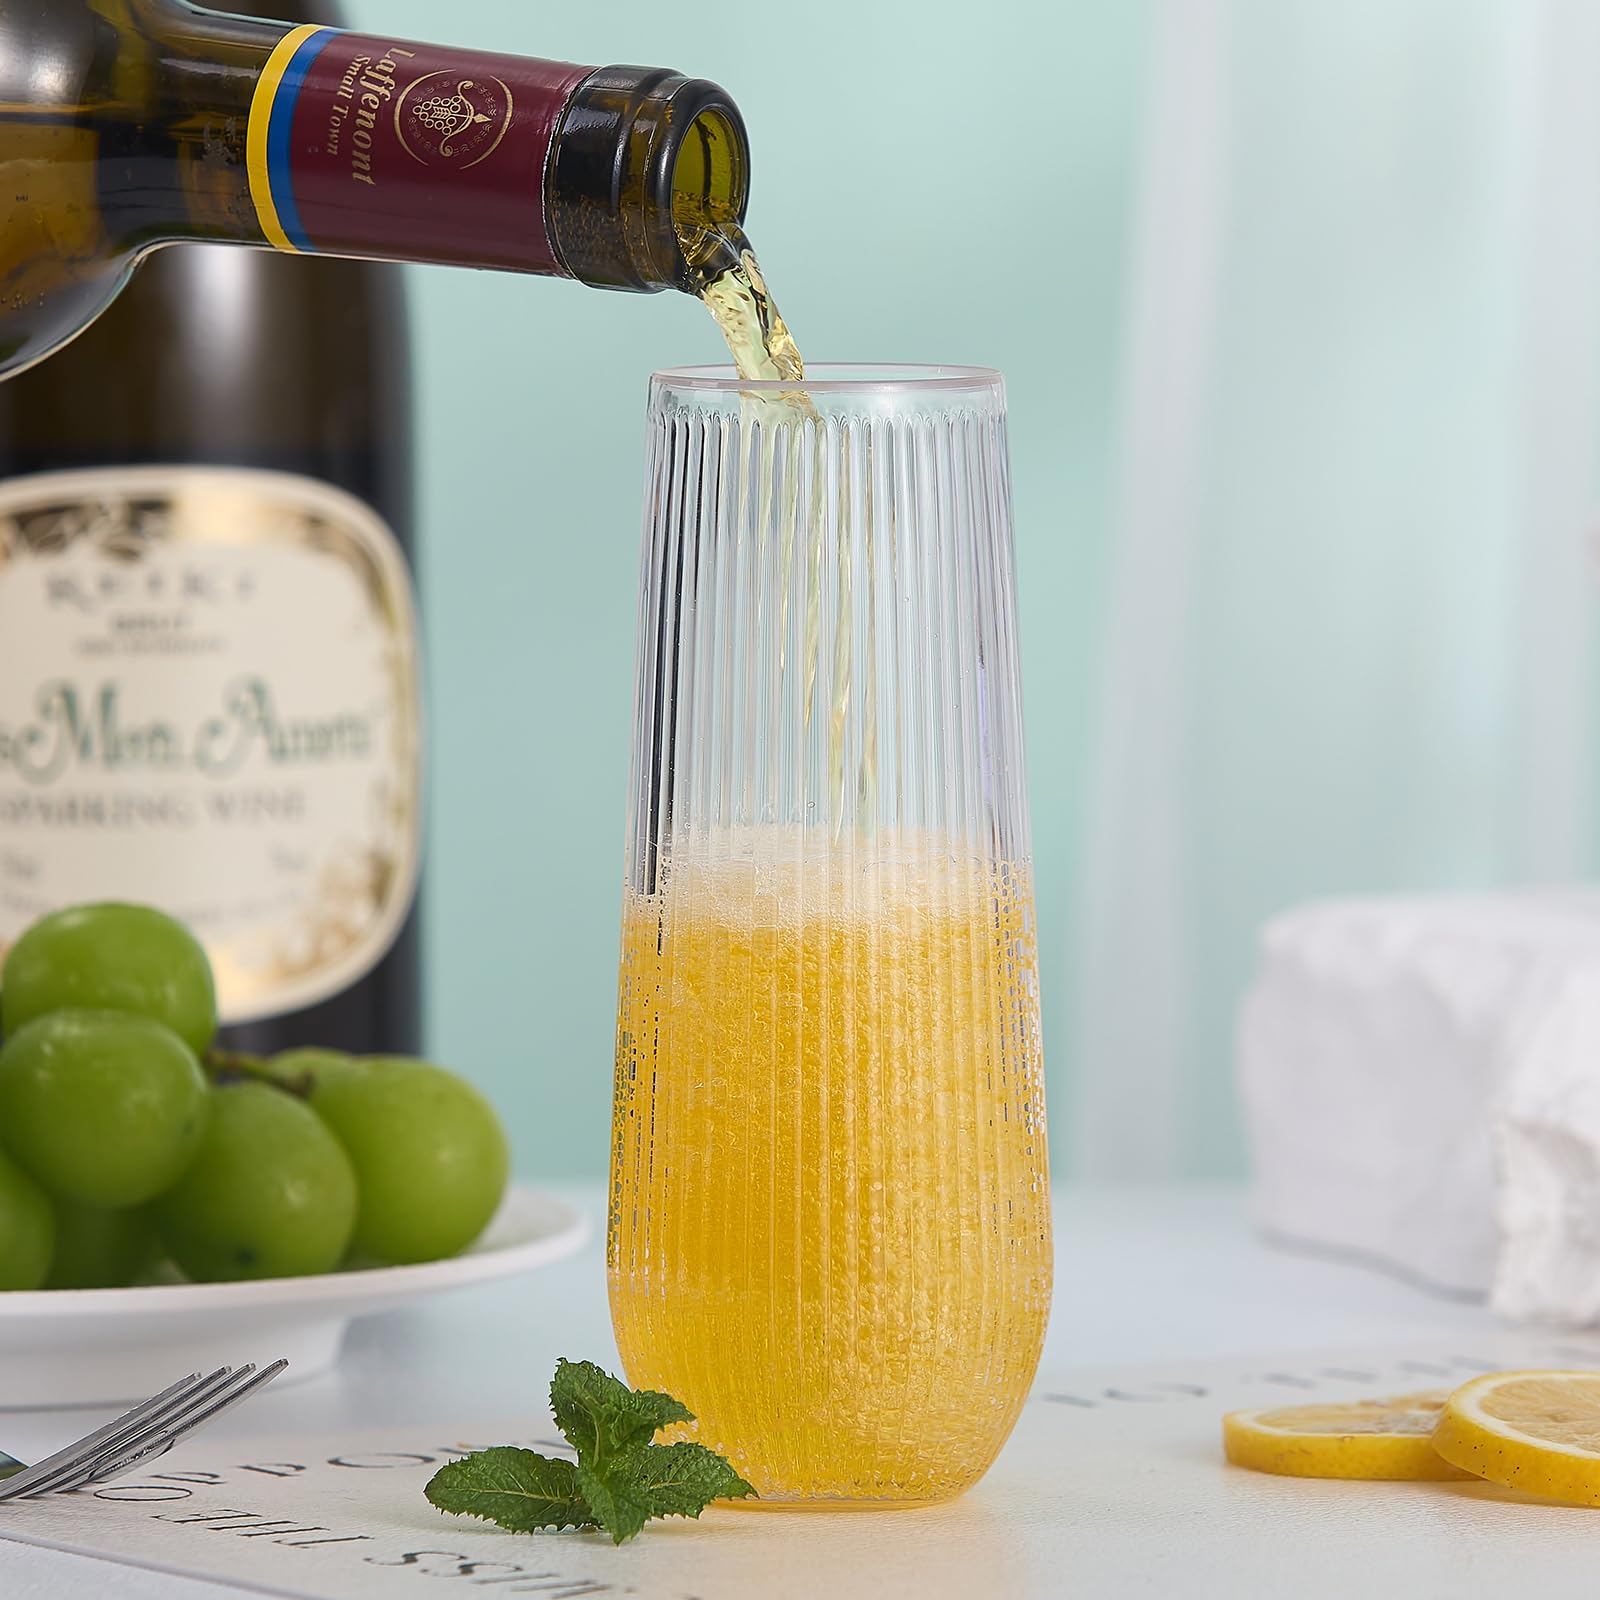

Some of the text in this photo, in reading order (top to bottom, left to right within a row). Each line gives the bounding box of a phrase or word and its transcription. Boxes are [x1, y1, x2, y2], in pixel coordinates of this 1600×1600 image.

[326, 53, 373, 156] Small Town
[149, 1507, 375, 1550] THE
